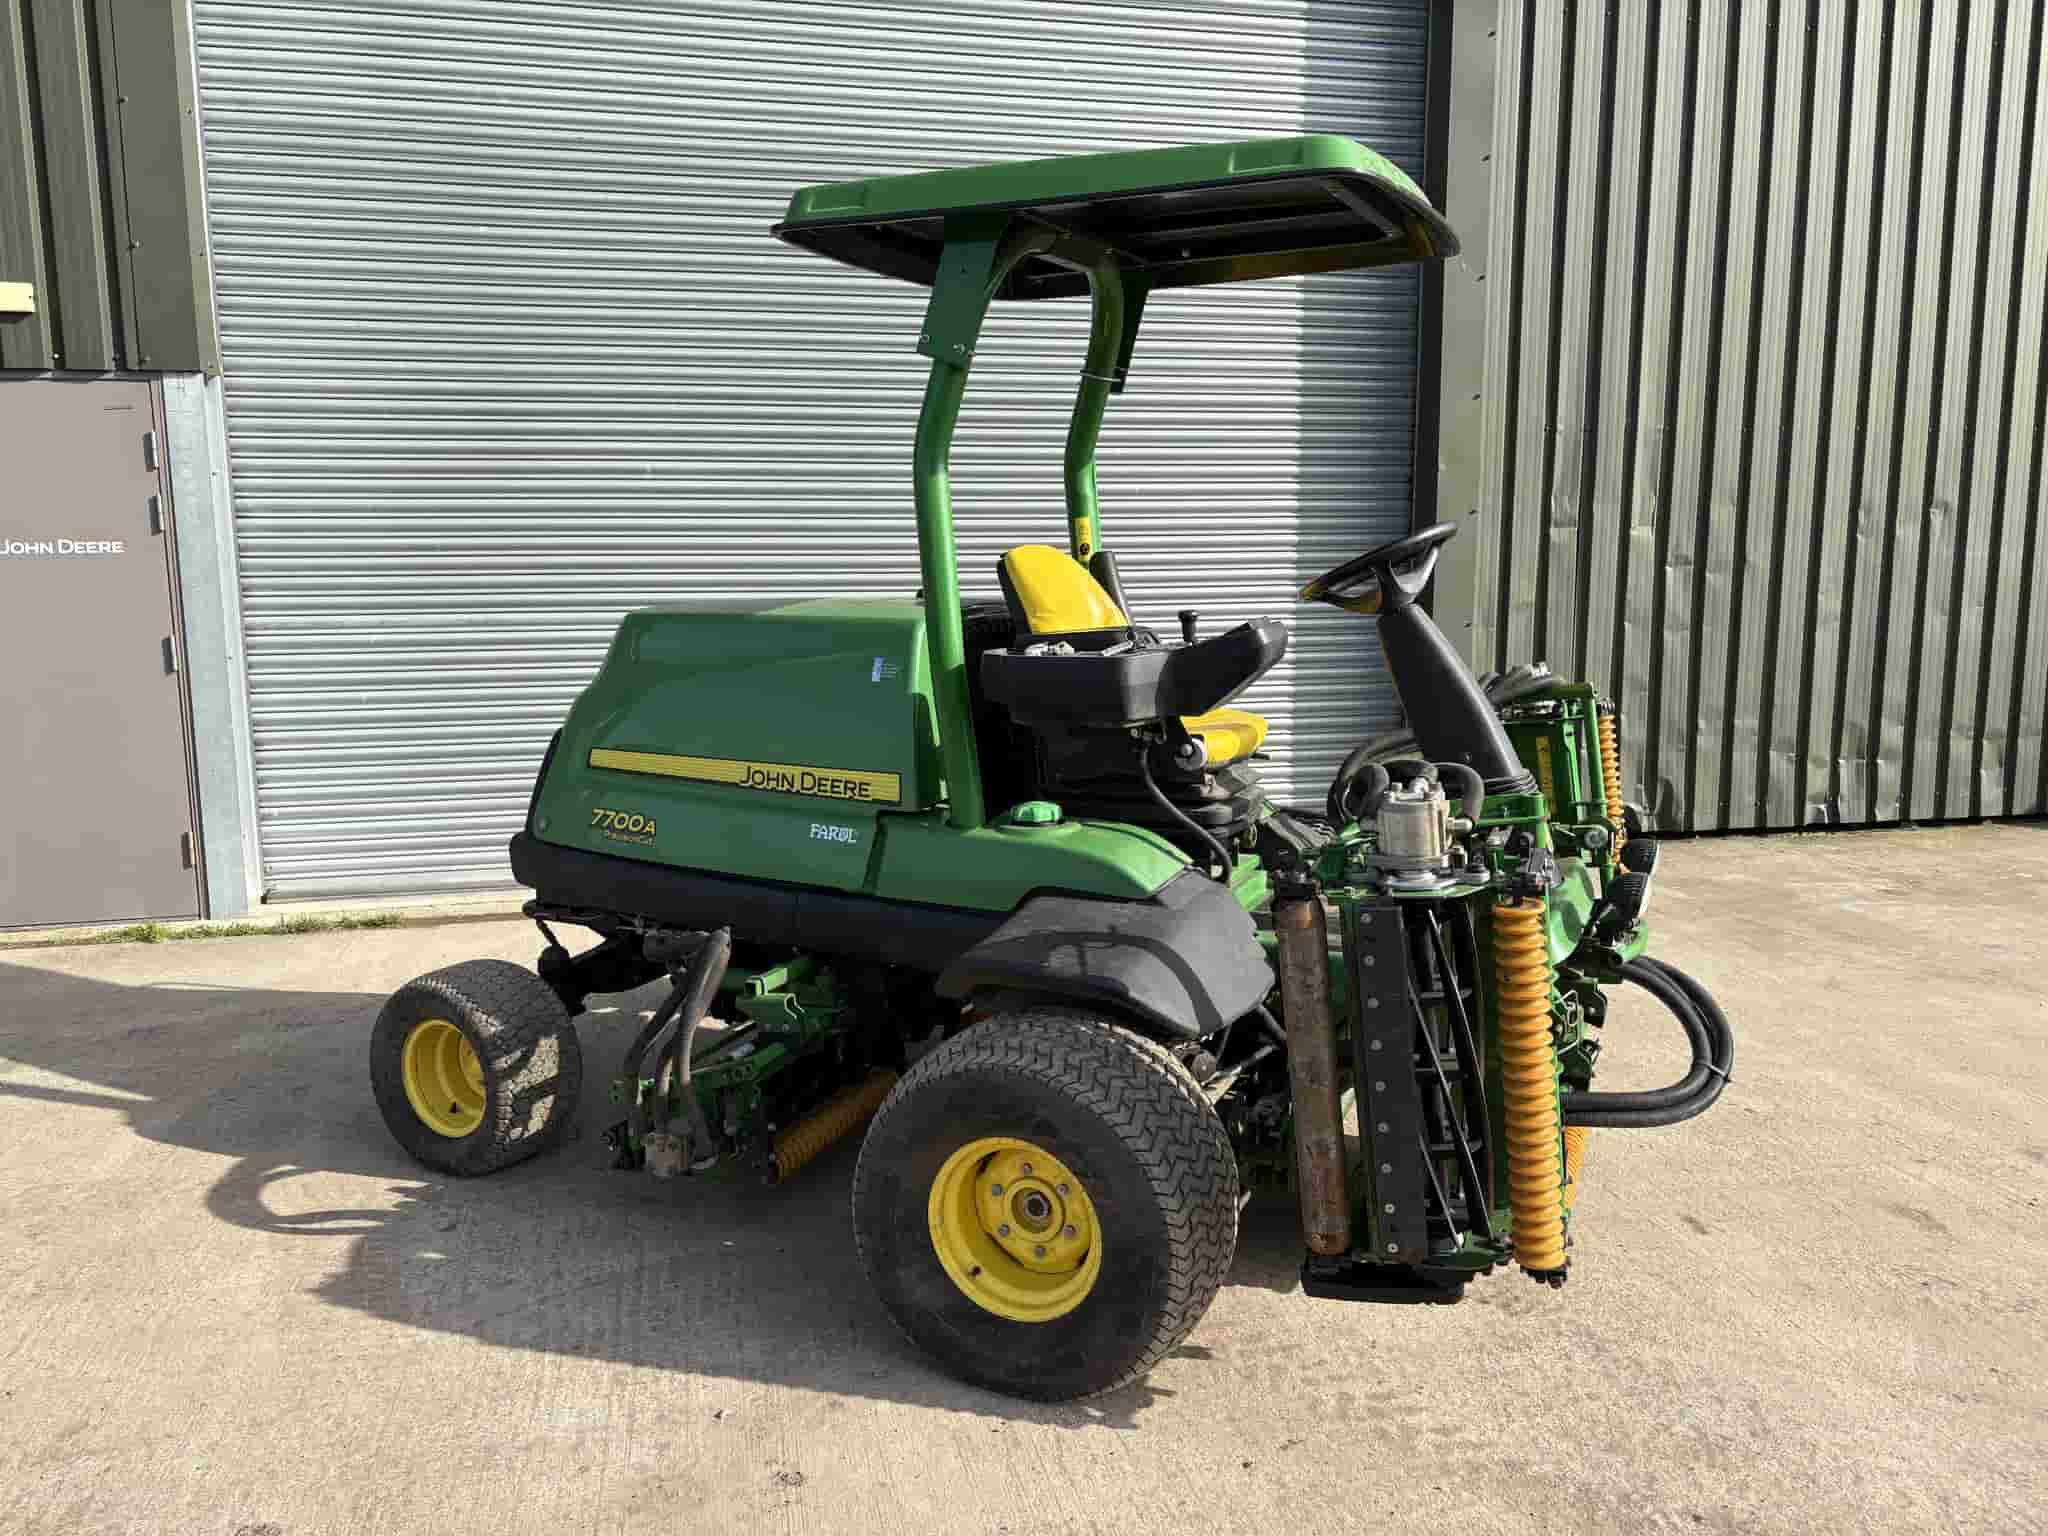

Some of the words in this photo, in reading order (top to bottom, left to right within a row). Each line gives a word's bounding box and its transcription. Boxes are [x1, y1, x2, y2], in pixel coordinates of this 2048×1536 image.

[0, 539, 54, 554] JOHN
[58, 539, 125, 554] DEERE
[740, 765, 794, 790] JOHN
[800, 771, 872, 799] DEERE
[591, 808, 656, 833] 7700A
[810, 823, 857, 843] FAROL
